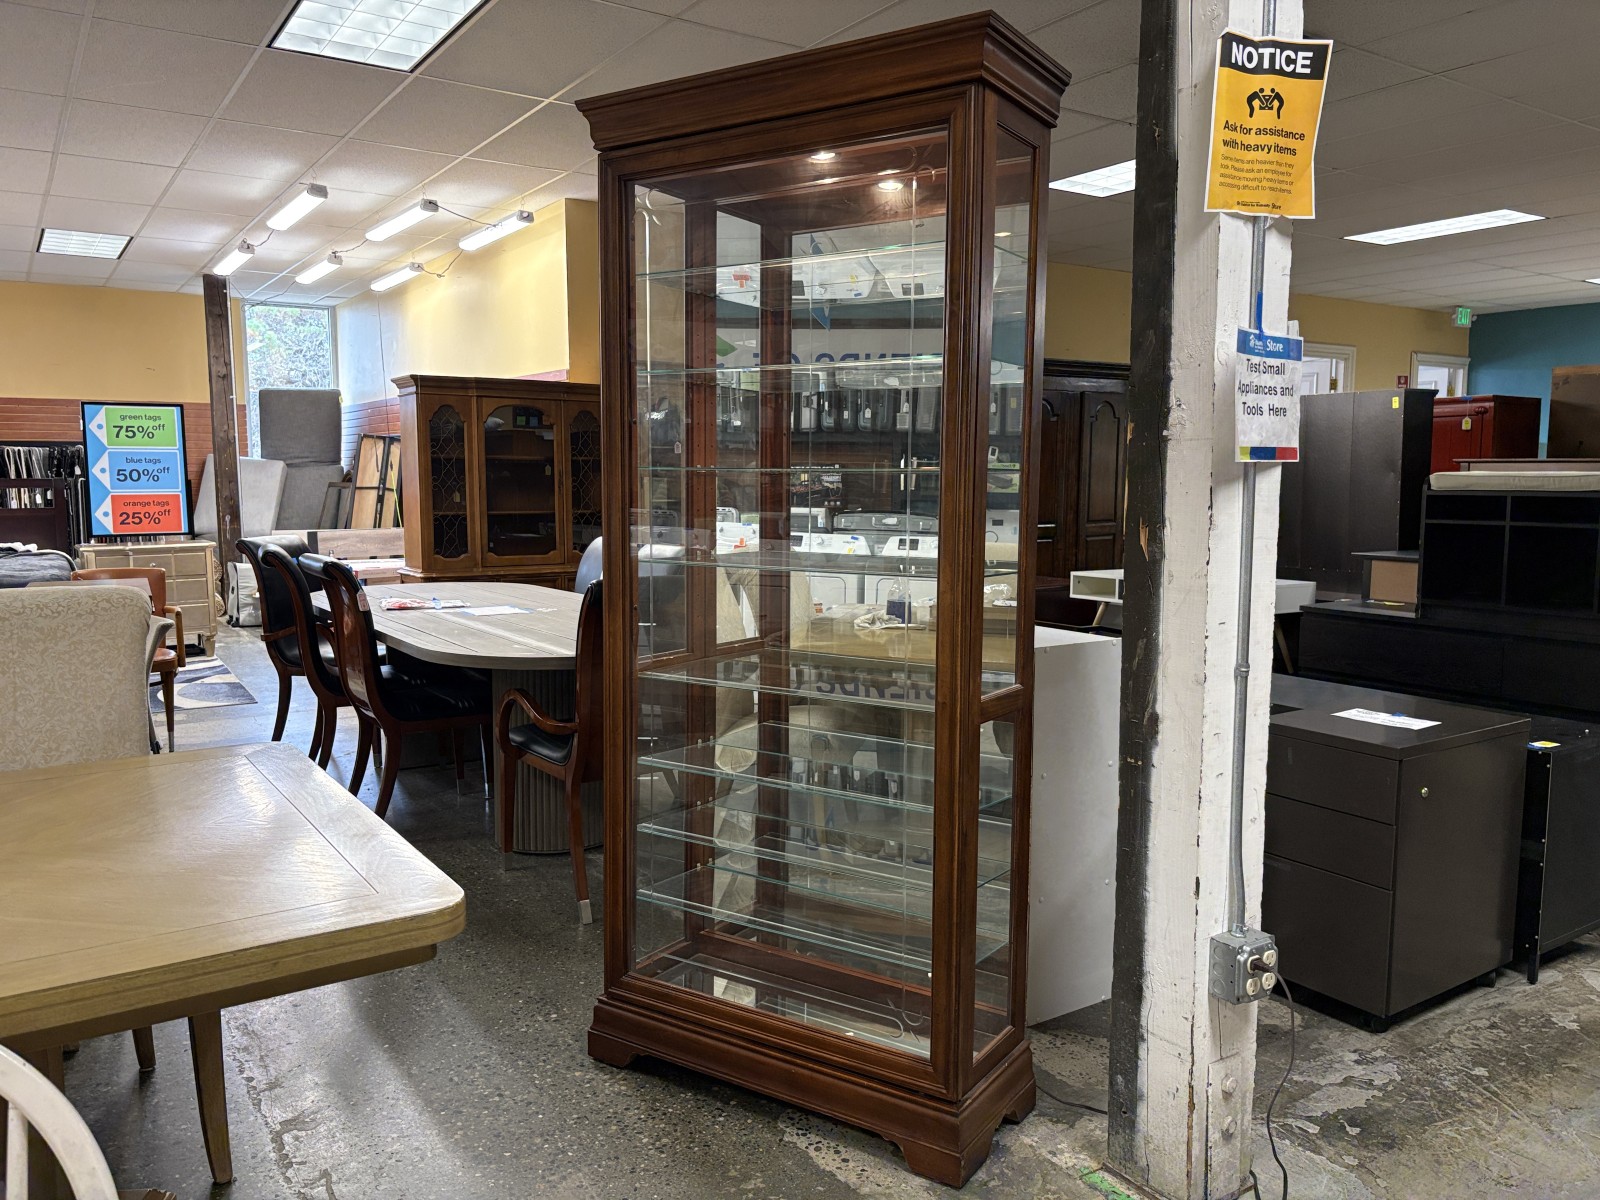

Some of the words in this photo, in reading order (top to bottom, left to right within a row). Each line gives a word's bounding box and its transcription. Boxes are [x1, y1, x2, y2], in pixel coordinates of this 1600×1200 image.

[1231, 41, 1314, 74] NOTICE
[1223, 119, 1239, 134] Ask
[1239, 123, 1253, 136] for
[1254, 125, 1306, 141] assistance
[1222, 138, 1239, 151] with
[1240, 139, 1273, 155] heavy
[1273, 141, 1297, 156] items
[1256, 158, 1275, 167] heavier
[1284, 162, 1295, 170] they
[1242, 175, 1263, 184] moving
[1457, 307, 1471, 325] EXIT
[1266, 338, 1284, 352] Store
[1246, 358, 1261, 373] Test
[1262, 361, 1286, 376] Small
[1237, 378, 1278, 397] Appliances
[1279, 384, 1294, 397] and
[119, 414, 143, 422] green
[144, 413, 162, 422] tags
[1242, 401, 1264, 416] Tools
[1268, 403, 1287, 417] Here
[112, 425, 155, 440] 75%
[152, 423, 166, 432] off
[125, 456, 143, 464] blue
[144, 457, 162, 465] tags
[116, 468, 160, 483] 50%
[156, 466, 171, 475] off
[152, 500, 170, 508] tags
[119, 511, 161, 526] 25%
[157, 509, 171, 517] off
